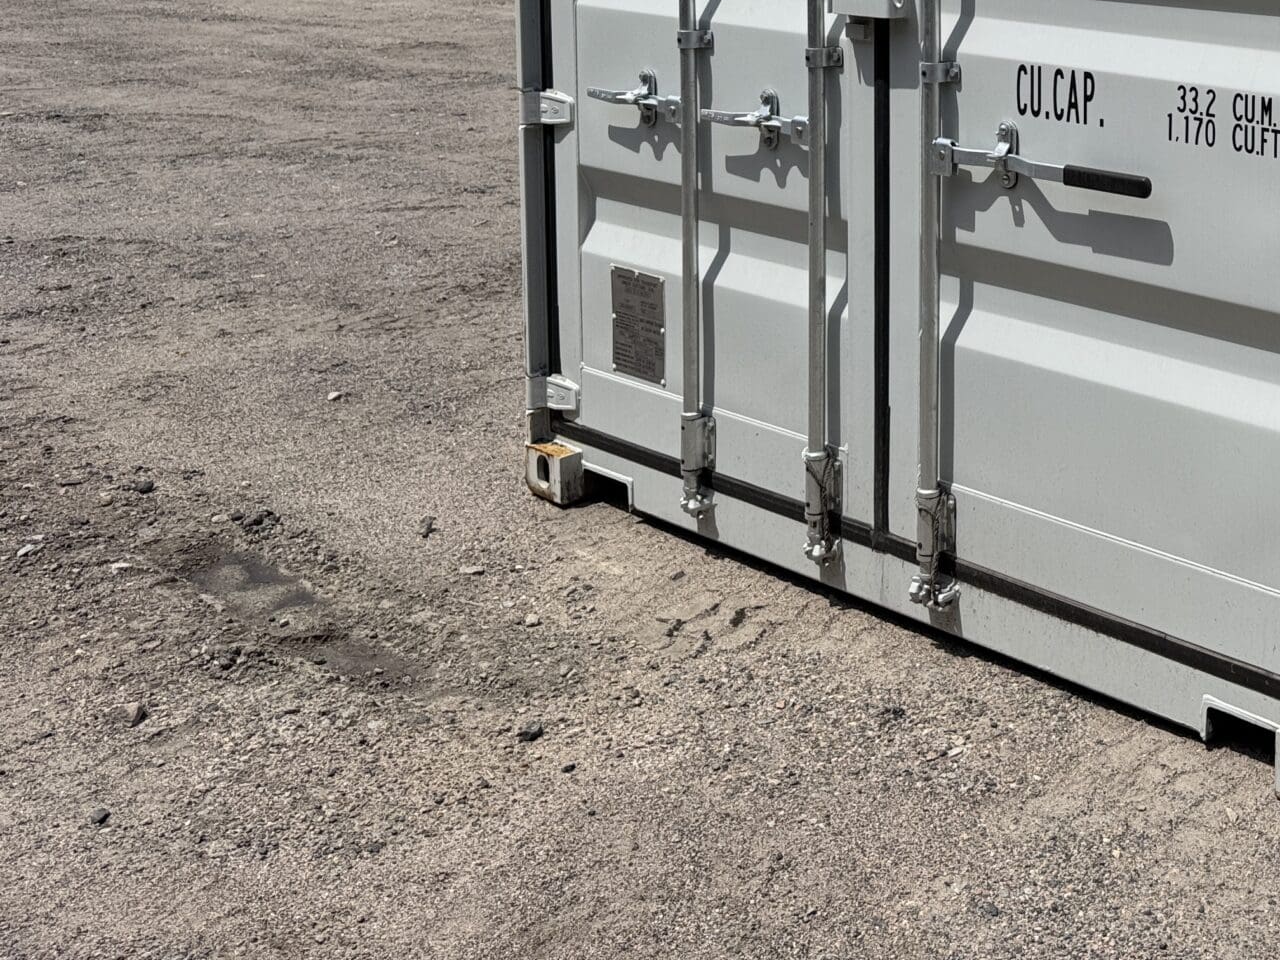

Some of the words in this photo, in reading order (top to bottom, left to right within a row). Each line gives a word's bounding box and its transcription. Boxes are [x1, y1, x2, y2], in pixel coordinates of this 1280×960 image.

[1016, 63, 1105, 128] CU.CAP.
[1176, 84, 1217, 118] 33.2
[1232, 93, 1278, 128] CU.M.
[1167, 113, 1216, 147] 1,170
